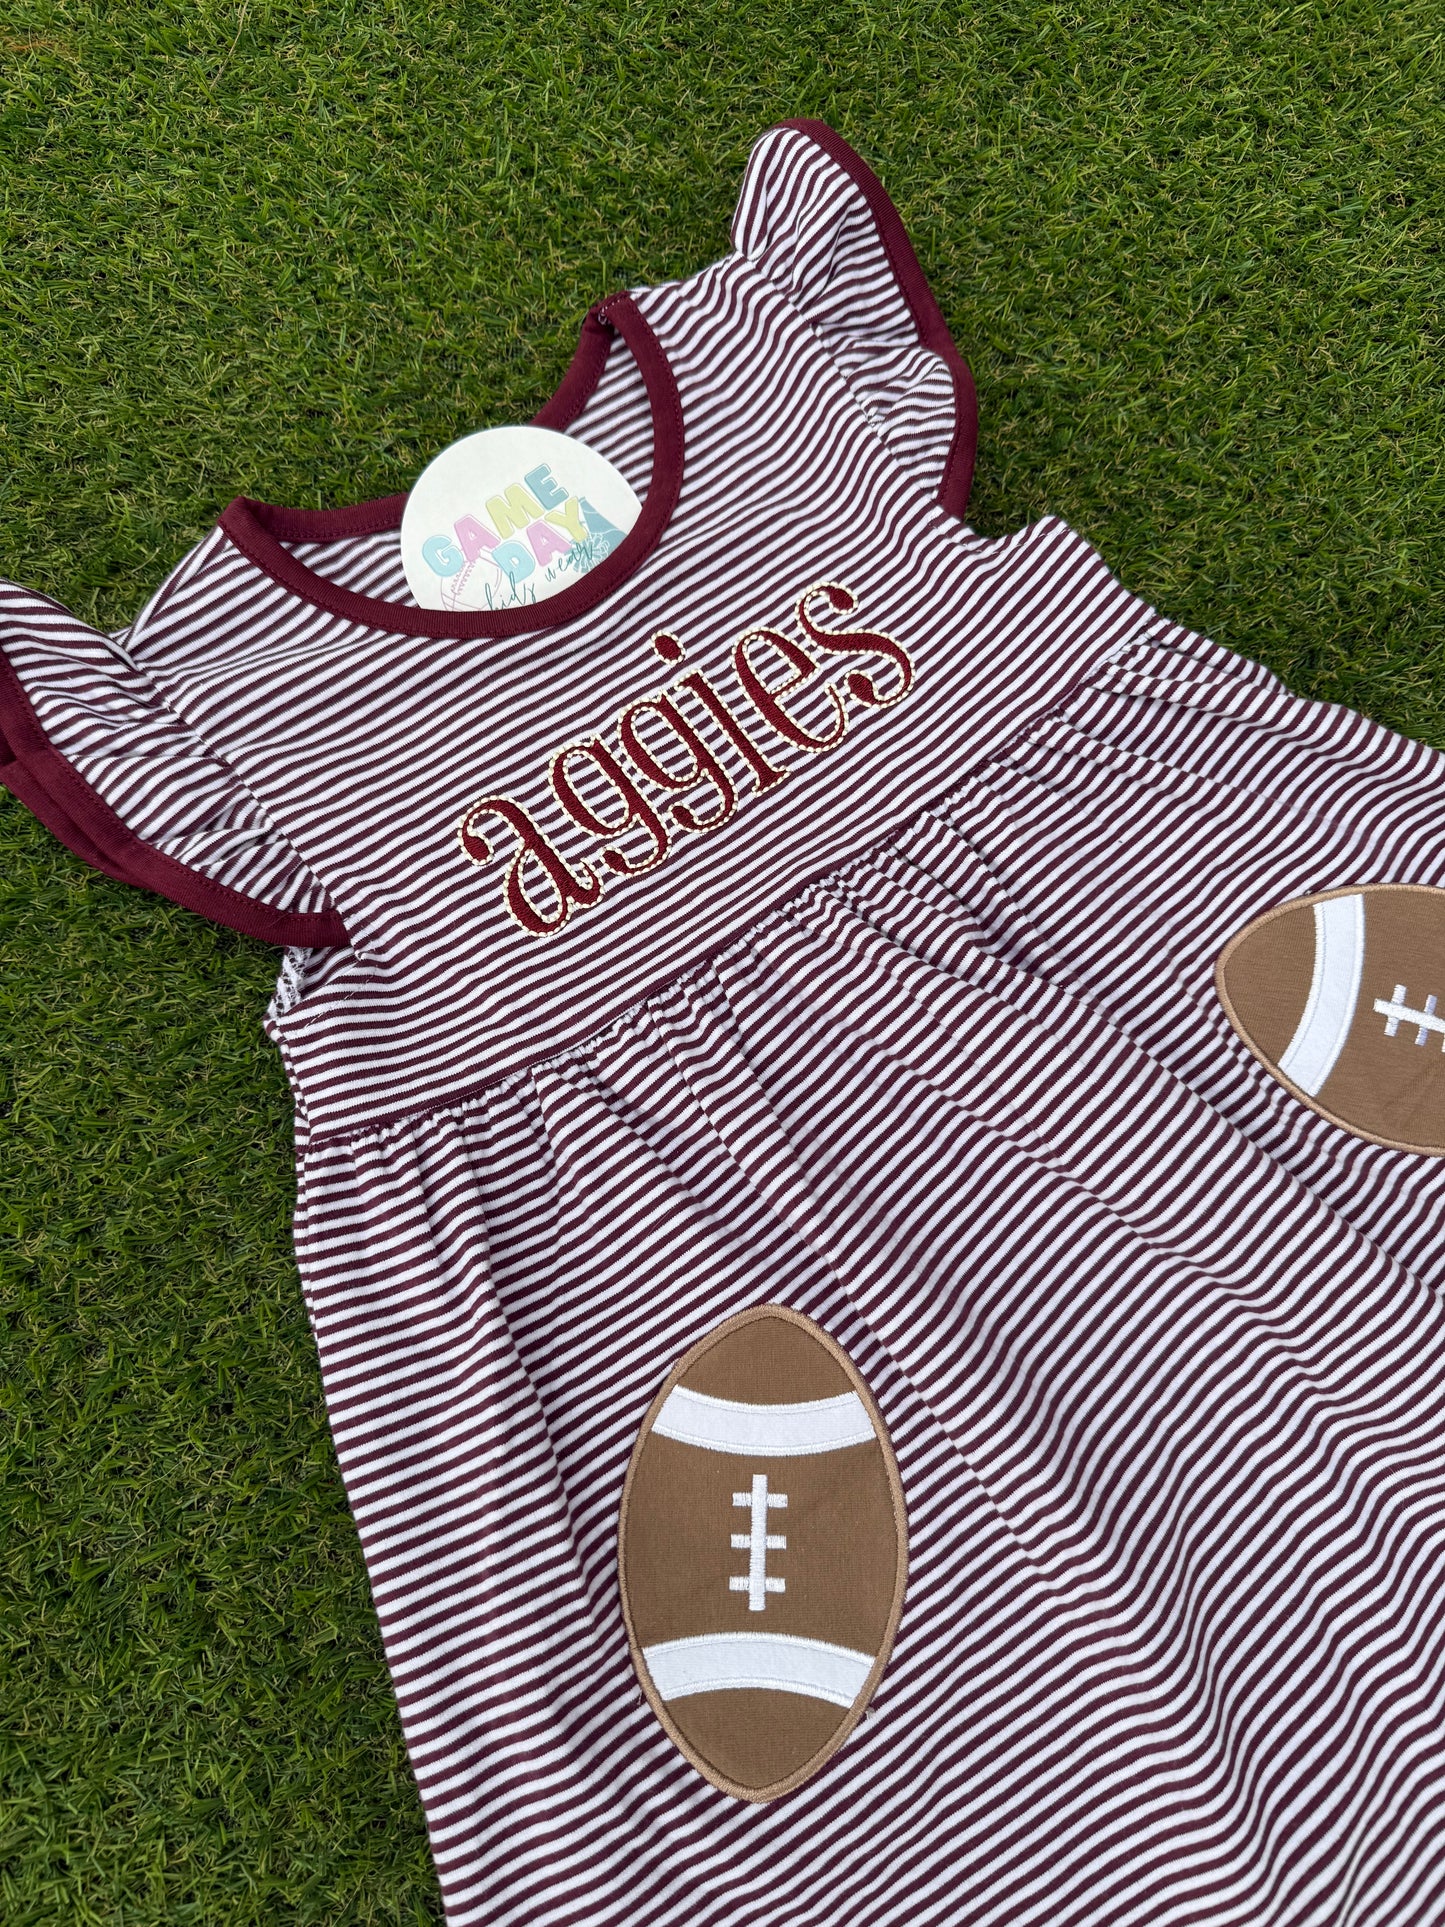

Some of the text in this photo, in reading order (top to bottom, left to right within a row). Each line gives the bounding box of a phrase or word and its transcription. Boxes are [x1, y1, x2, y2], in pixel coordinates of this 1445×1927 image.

[421, 463, 569, 577] GAME
[491, 496, 588, 583] DAY
[458, 581, 916, 937] aggies
